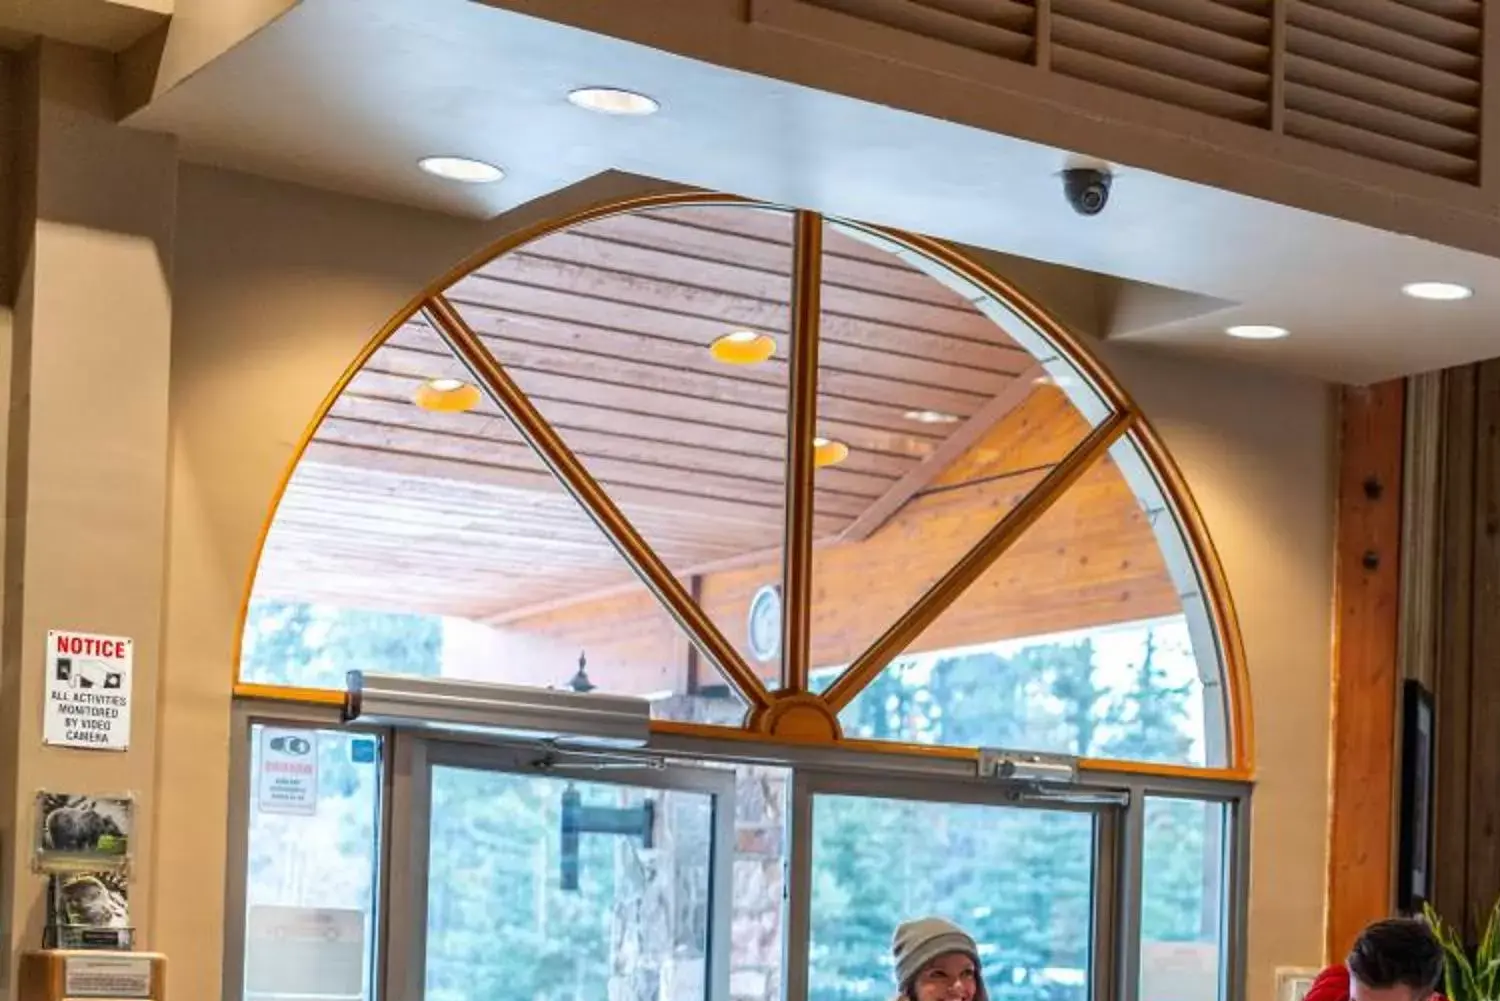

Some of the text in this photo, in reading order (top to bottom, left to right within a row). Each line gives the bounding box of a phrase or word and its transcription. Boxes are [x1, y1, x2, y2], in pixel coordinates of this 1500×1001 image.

[57, 636, 125, 658] NOTICE
[52, 691, 127, 706] ALL ACTIVITIES
[58, 704, 118, 718] MONITORED
[64, 718, 111, 731] BY VIDEO
[66, 731, 109, 743] CAMERA
